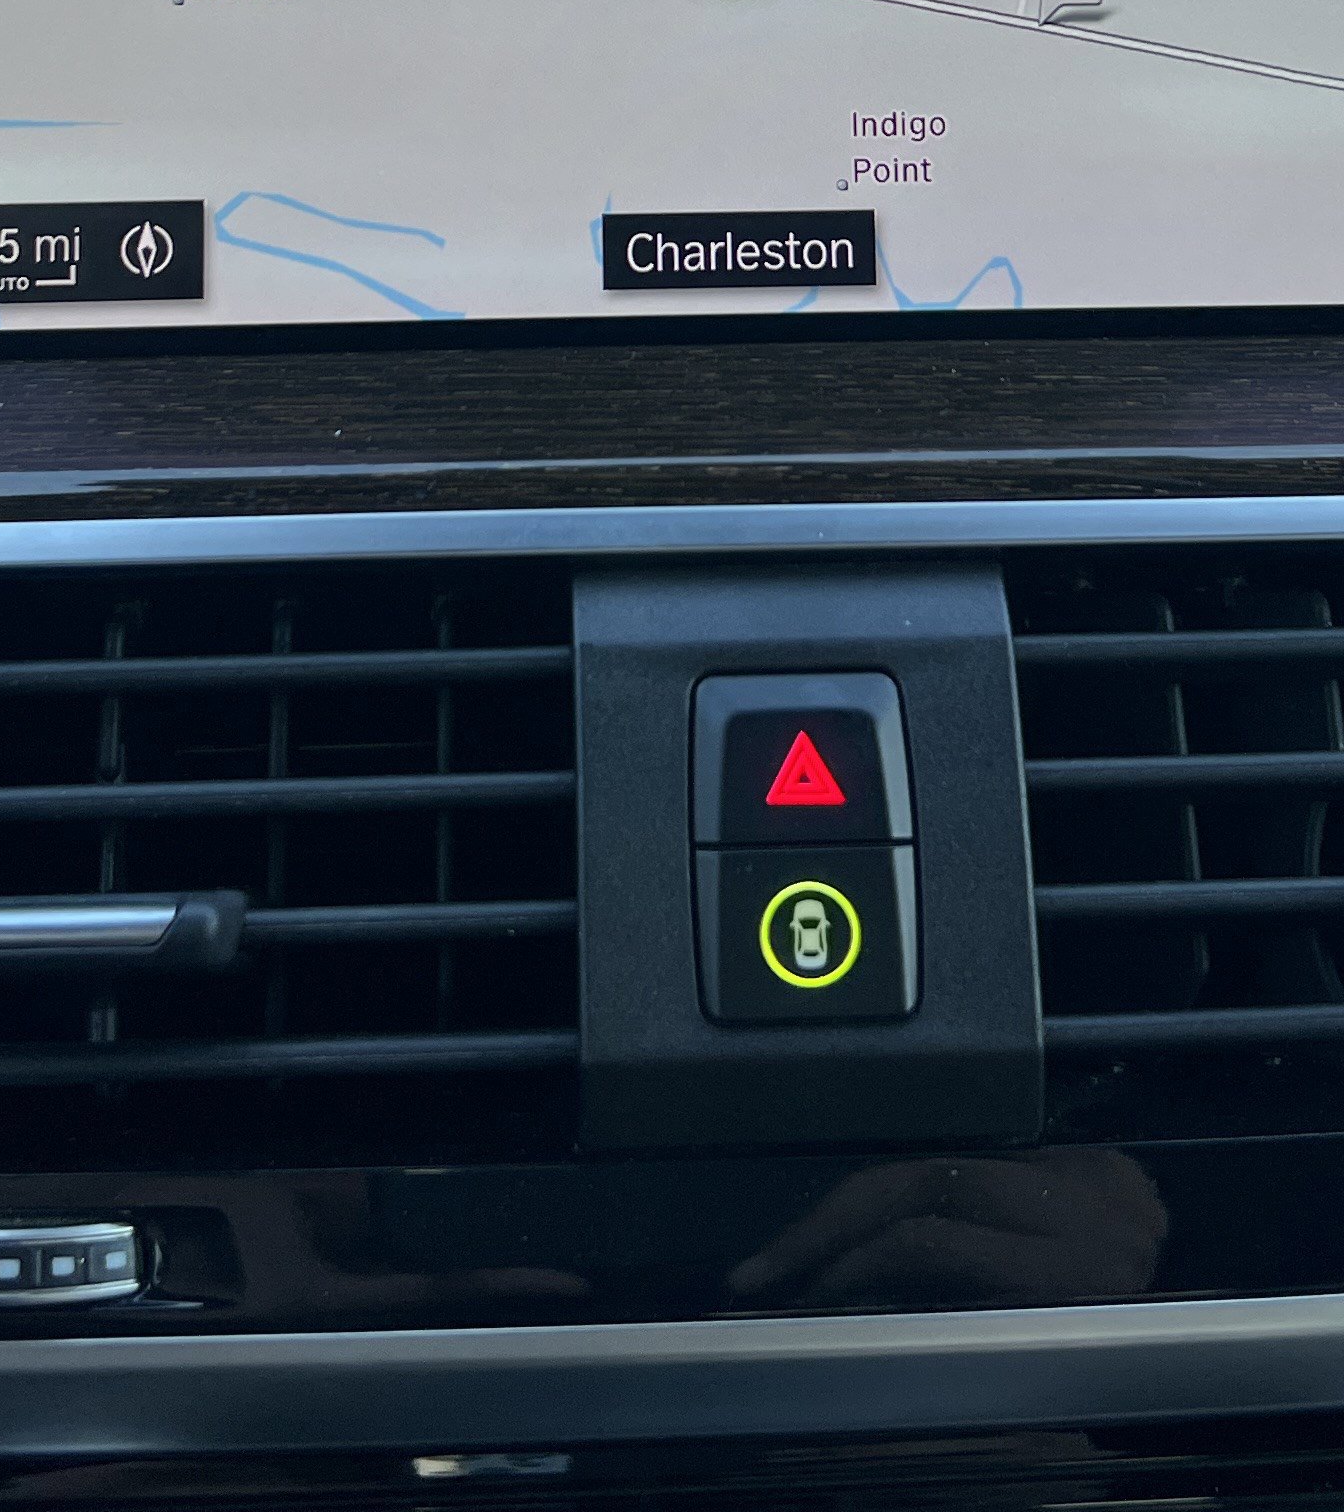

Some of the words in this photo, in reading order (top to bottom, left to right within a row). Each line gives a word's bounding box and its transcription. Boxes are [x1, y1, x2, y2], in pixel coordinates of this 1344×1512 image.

[852, 111, 946, 142] Indigo
[853, 157, 932, 183] Point
[34, 226, 81, 263] mi
[626, 231, 855, 273] Charleston
